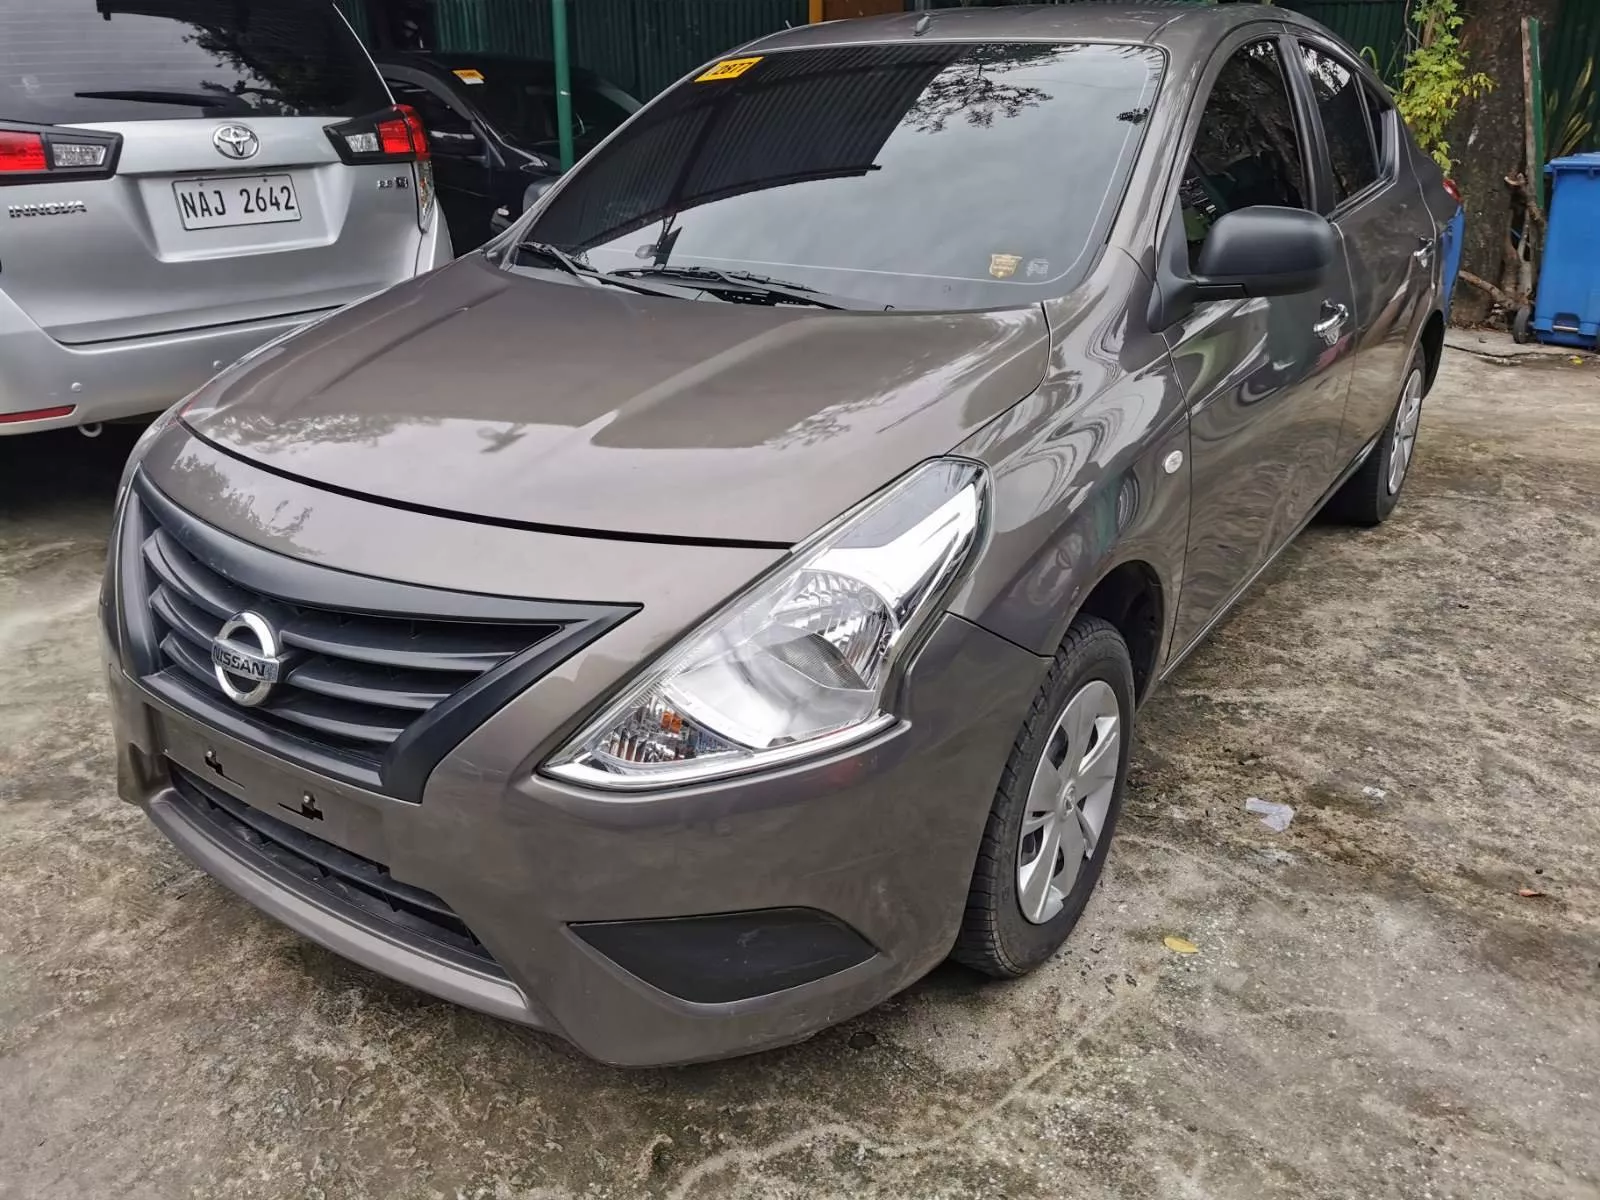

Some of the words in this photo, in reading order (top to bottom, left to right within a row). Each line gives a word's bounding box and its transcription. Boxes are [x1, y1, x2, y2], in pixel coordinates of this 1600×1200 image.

[8, 200, 87, 218] INNOVA
[180, 190, 226, 218] NAJ
[239, 186, 295, 214] 2642
[213, 645, 266, 677] NISSAN
